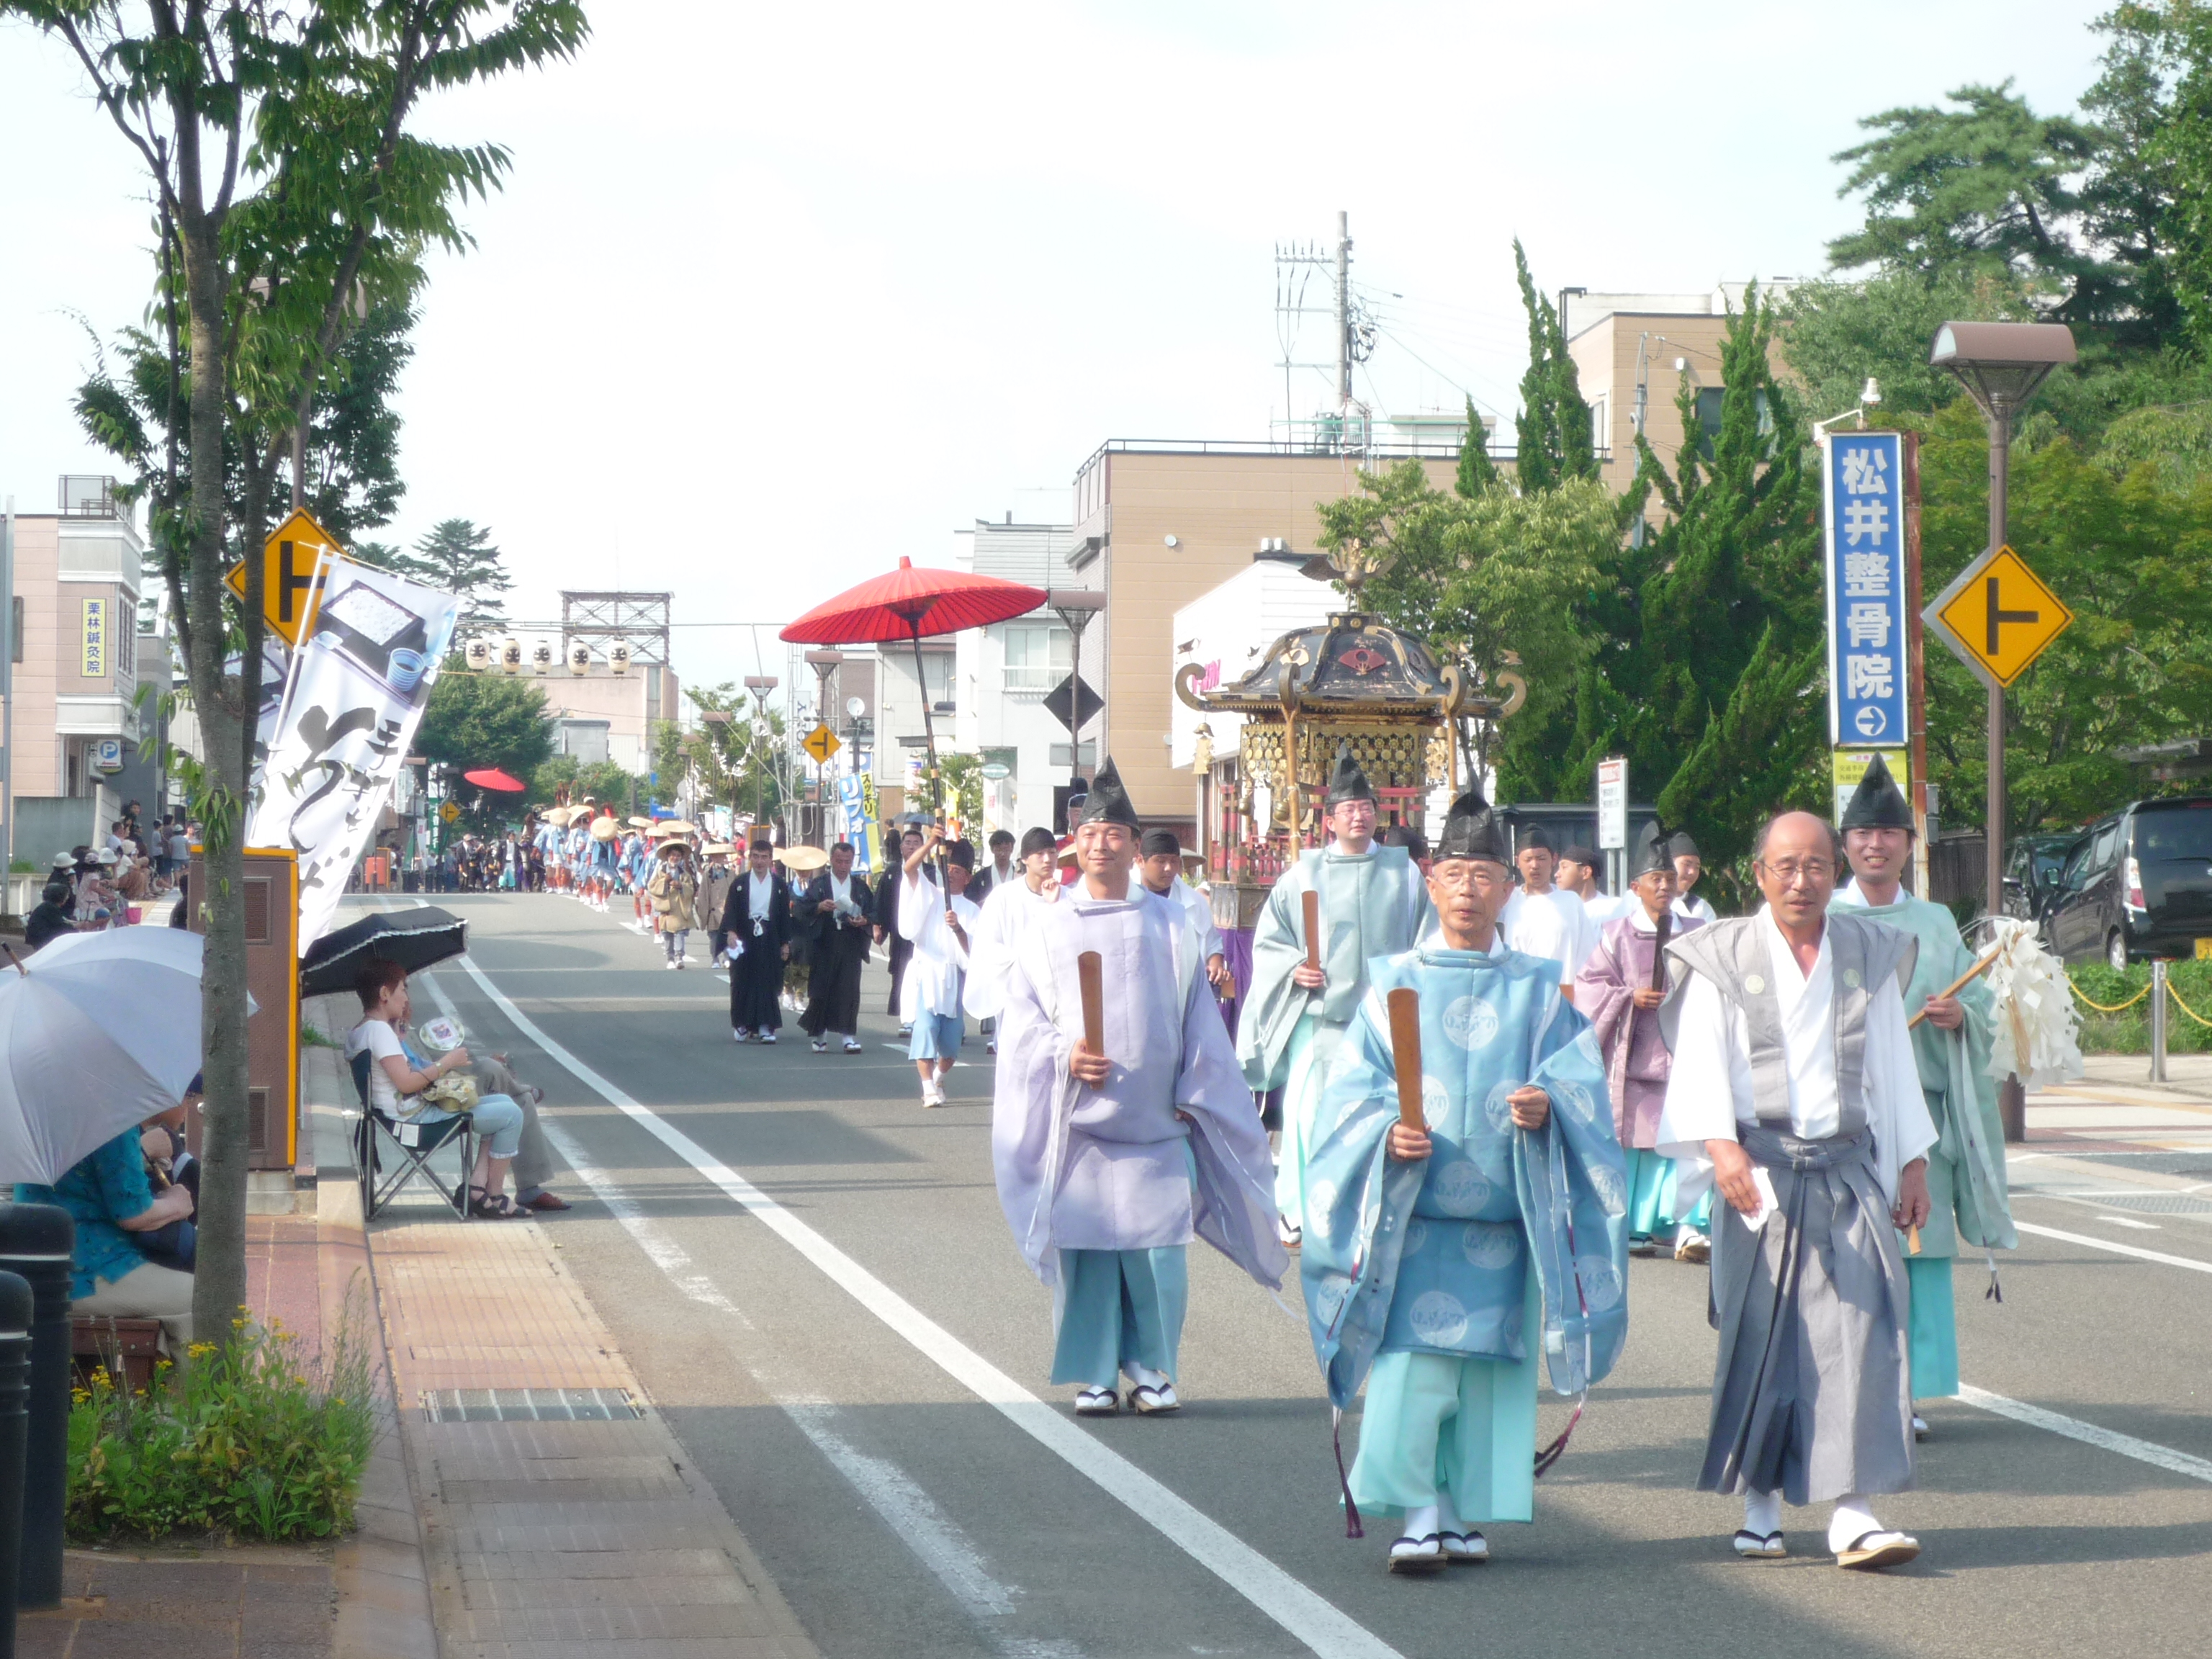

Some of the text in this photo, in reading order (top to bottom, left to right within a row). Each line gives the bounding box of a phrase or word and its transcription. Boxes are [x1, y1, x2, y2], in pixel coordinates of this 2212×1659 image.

[1842, 449, 1893, 700] 松井整骨院
[87, 602, 100, 673] 栗林鍼灸院
[103, 744, 116, 756] P
[841, 777, 871, 873] リフォーム
[861, 774, 873, 814] スッキリ
